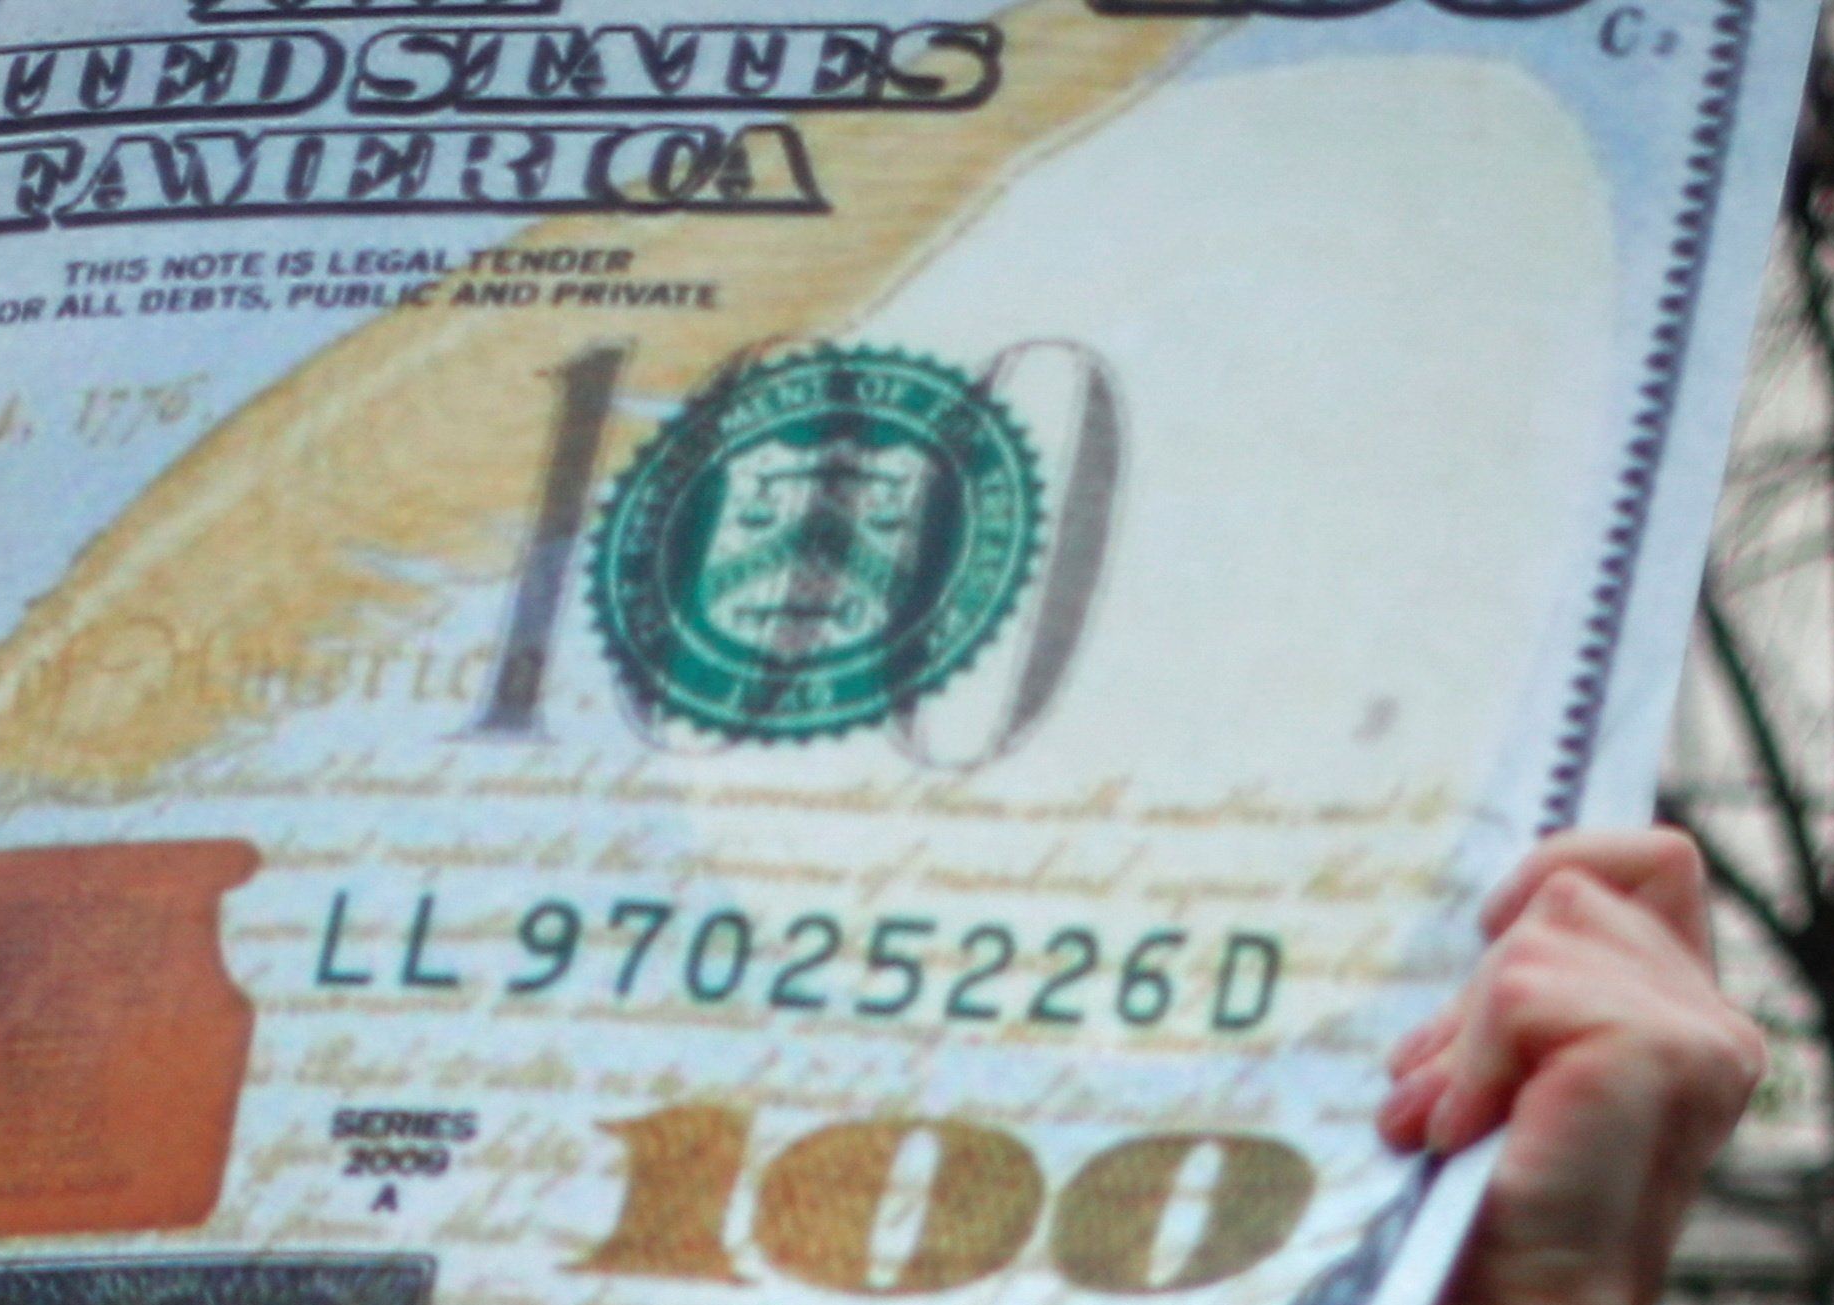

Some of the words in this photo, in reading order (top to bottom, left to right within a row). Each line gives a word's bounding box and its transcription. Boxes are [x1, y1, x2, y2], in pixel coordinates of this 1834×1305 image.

[347, 20, 1004, 116] STATES
[54, 123, 833, 229] AMERICA
[65, 256, 150, 287] THIS
[161, 251, 267, 281] NOTE
[276, 249, 316, 278] IS
[326, 247, 457, 278] LEGAL
[470, 247, 636, 276] TENDER
[54, 293, 123, 319] ALL
[138, 284, 272, 315] DEBTS,
[286, 281, 440, 309] PUBLIC
[448, 281, 541, 308] AND
[551, 281, 719, 311] PRIVATE
[331, 1109, 480, 1142] SERIES
[370, 1182, 399, 1213] A
[553, 1101, 1319, 1298] 100
